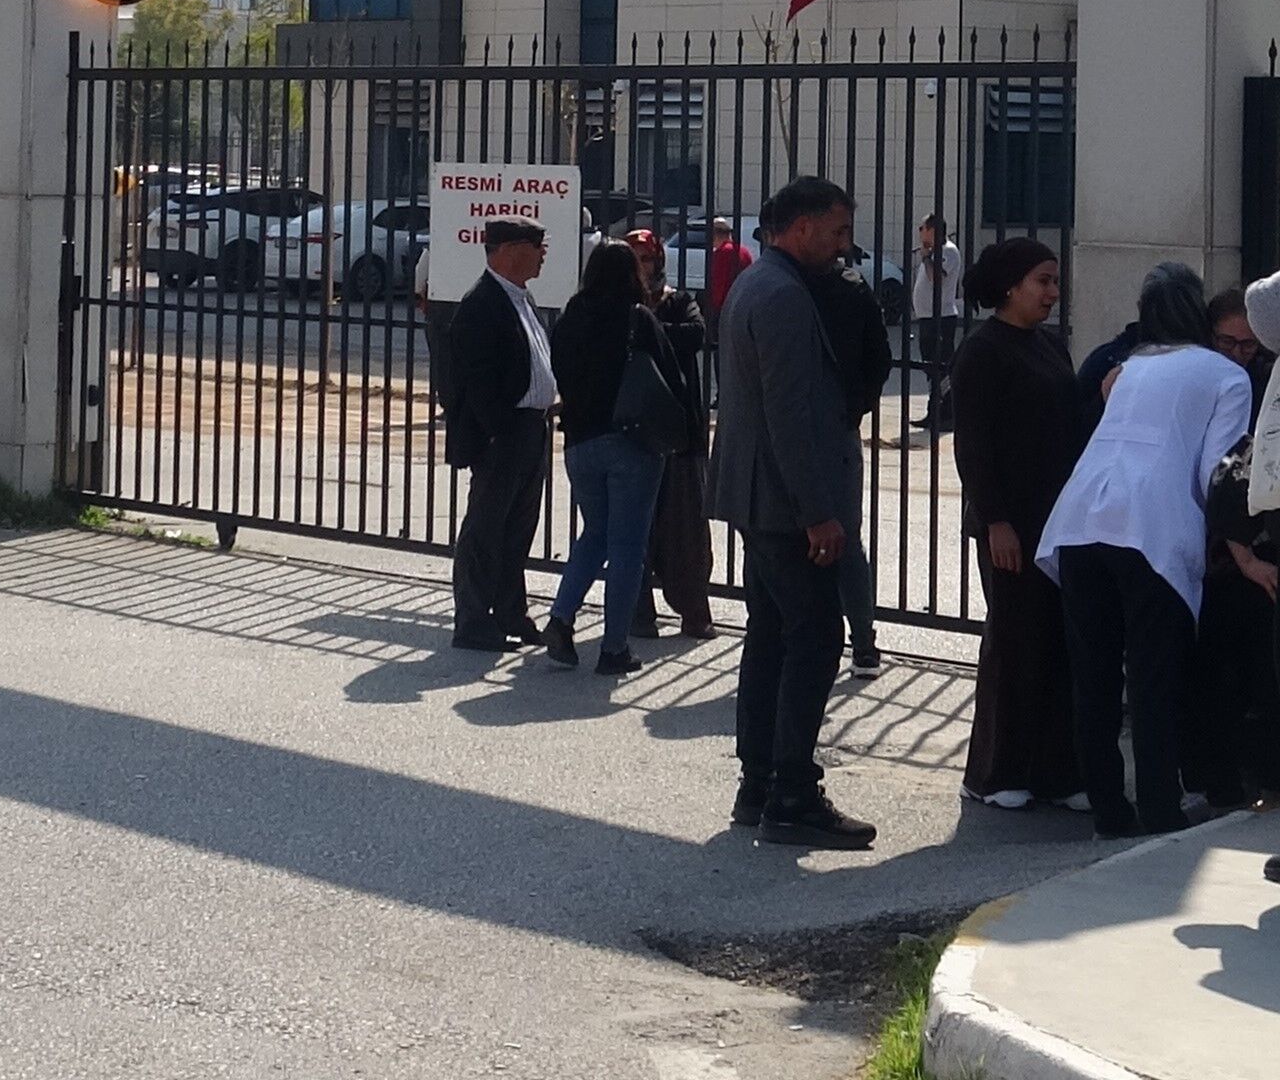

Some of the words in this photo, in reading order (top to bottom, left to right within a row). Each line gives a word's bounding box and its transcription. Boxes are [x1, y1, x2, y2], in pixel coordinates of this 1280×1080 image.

[441, 173, 502, 193] RESMİ
[512, 178, 569, 199] ARAÇ
[470, 200, 539, 219] HARİCİ
